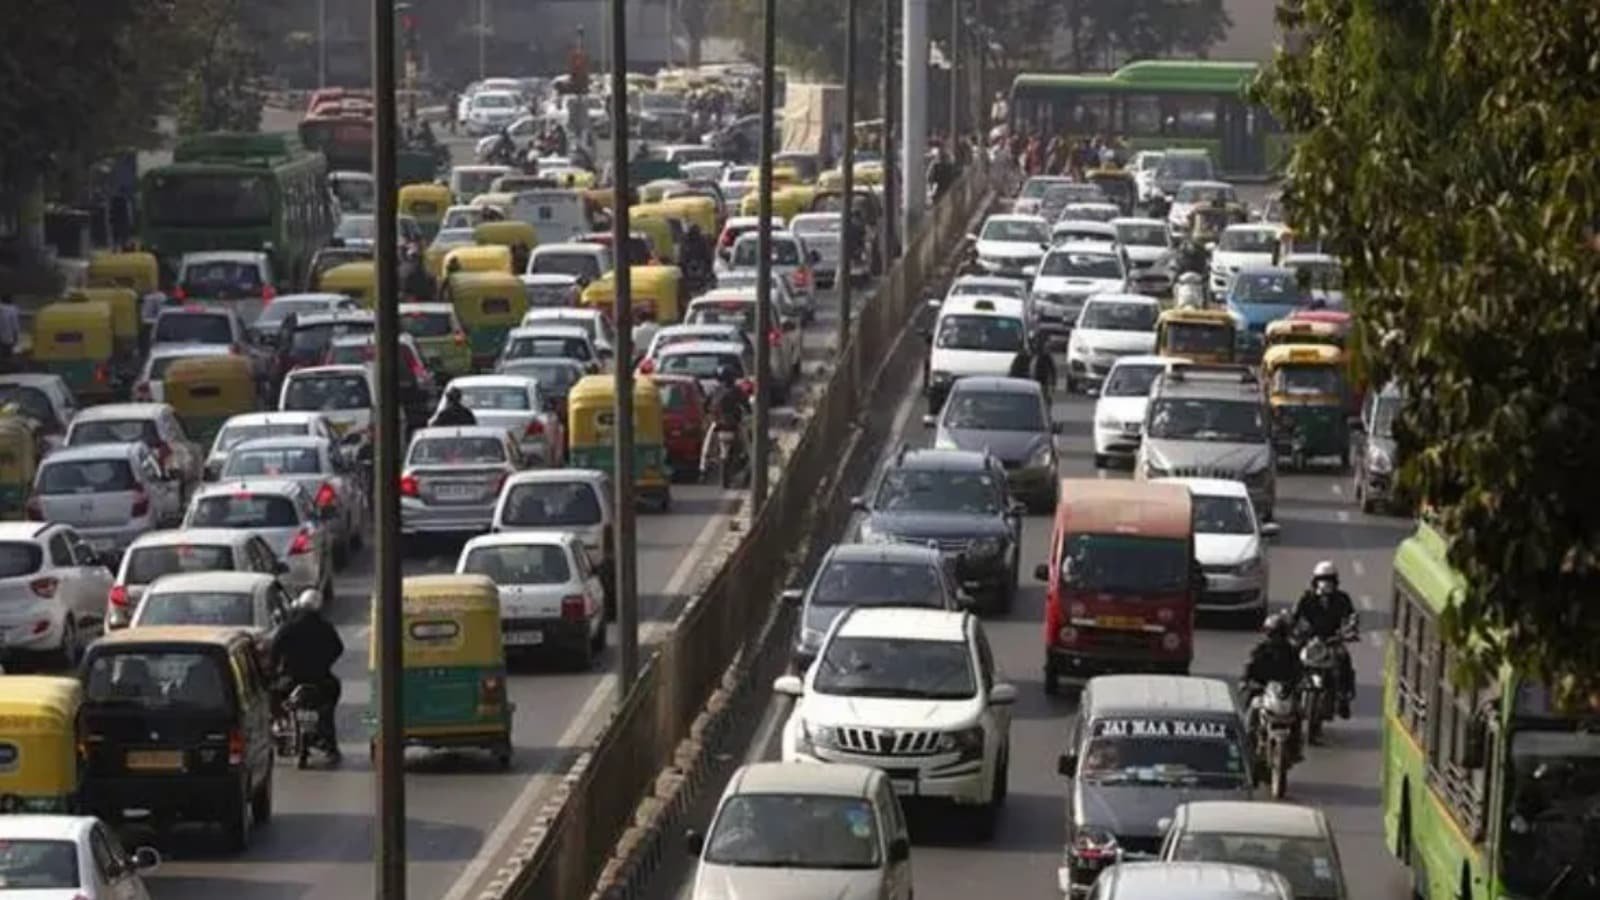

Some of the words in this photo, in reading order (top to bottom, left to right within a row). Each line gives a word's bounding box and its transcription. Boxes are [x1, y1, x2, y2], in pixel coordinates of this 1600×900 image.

[1102, 720, 1128, 736] JAI
[1132, 720, 1169, 736] MAA
[1174, 720, 1226, 738] KAALI
